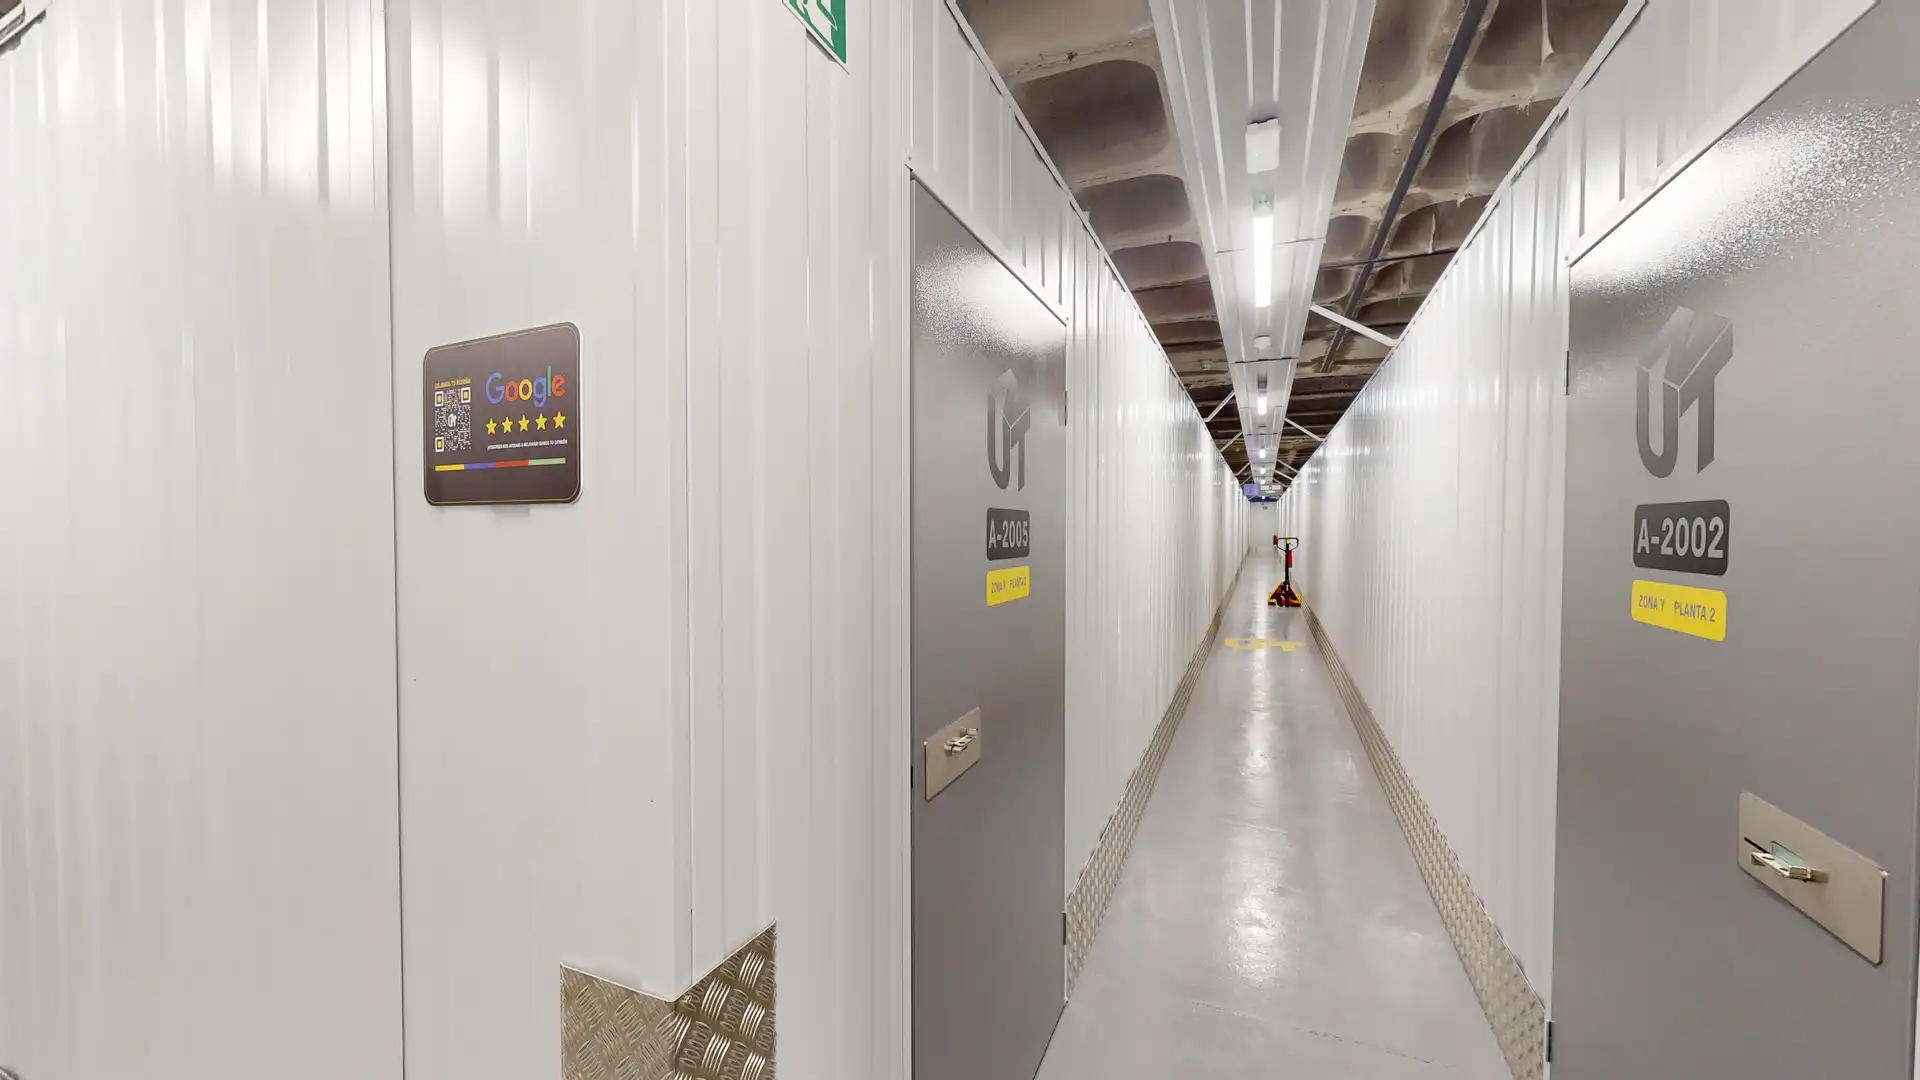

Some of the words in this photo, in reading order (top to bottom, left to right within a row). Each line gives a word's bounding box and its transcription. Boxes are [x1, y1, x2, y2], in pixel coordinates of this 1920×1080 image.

[485, 365, 565, 408] Google
[988, 519, 1028, 549] A-2005
[1637, 516, 1724, 559] A-2002
[1638, 594, 1658, 611] ZONA
[1660, 598, 1665, 613] Y
[1674, 601, 1707, 621] PLANTA
[1709, 607, 1716, 623] 2
